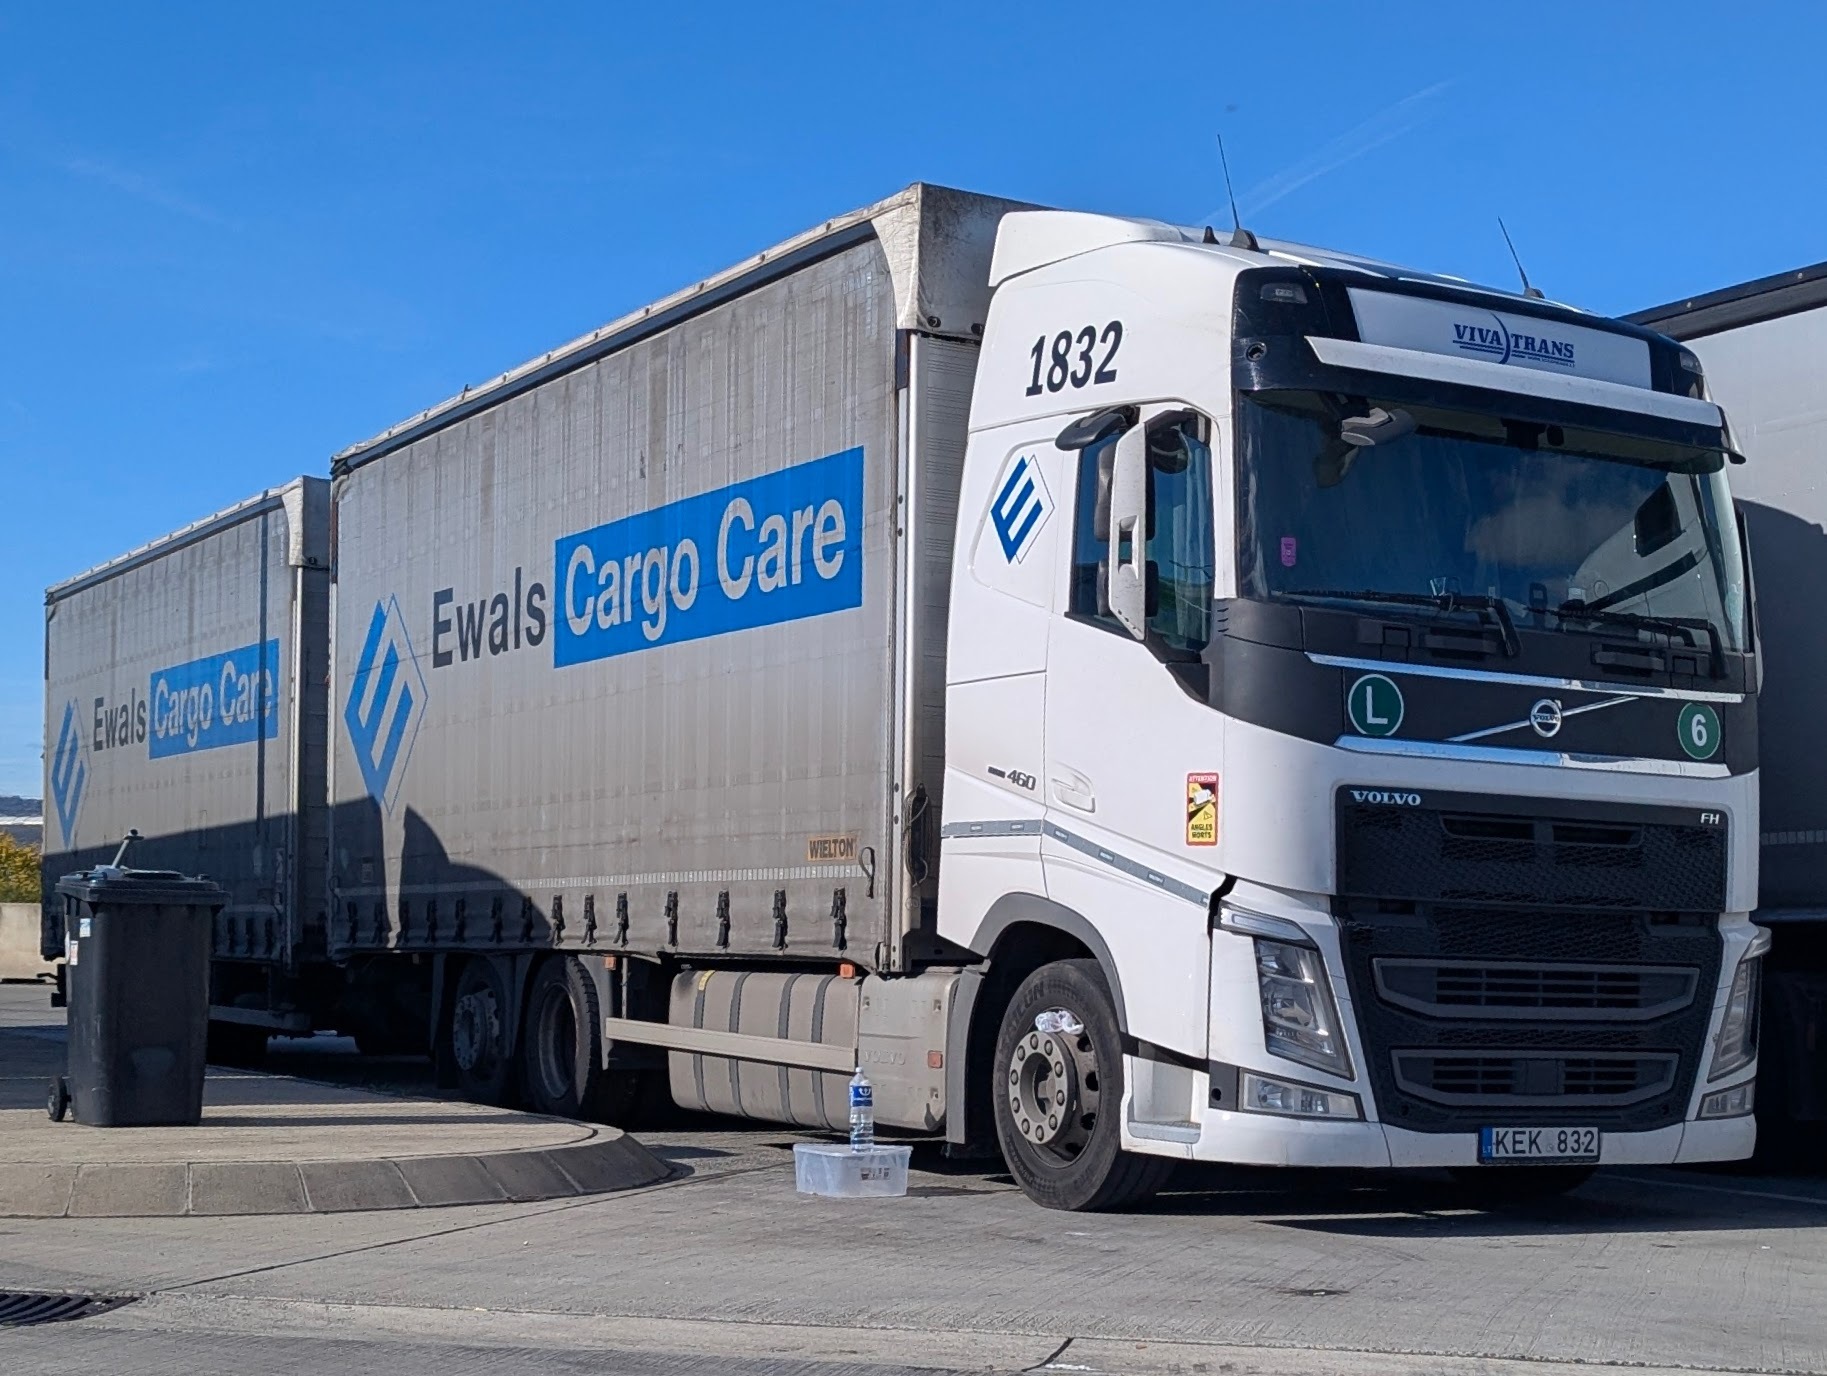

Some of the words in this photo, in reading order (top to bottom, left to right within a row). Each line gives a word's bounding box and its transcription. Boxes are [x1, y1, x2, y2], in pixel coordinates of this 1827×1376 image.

[1454, 323, 1503, 346] VIVA
[1511, 333, 1574, 358] TRANS
[1025, 320, 1123, 397] 1832
[433, 566, 546, 669] Ewals
[565, 544, 700, 641] Cargo
[718, 497, 846, 599] Care
[94, 687, 147, 751] Ewals
[154, 678, 213, 748] Cargo
[219, 660, 272, 726] Care
[1366, 685, 1388, 725] L
[1691, 713, 1708, 747] 6
[1007, 769, 1036, 791] 460
[1350, 790, 1421, 806] VOLVO
[1191, 823, 1213, 831] ANGLES
[1700, 812, 1720, 825] FH
[1191, 831, 1212, 839] MORTS
[809, 837, 854, 859] WIELTON
[1495, 1130, 1543, 1155] KEK
[1557, 1130, 1595, 1154] 832
